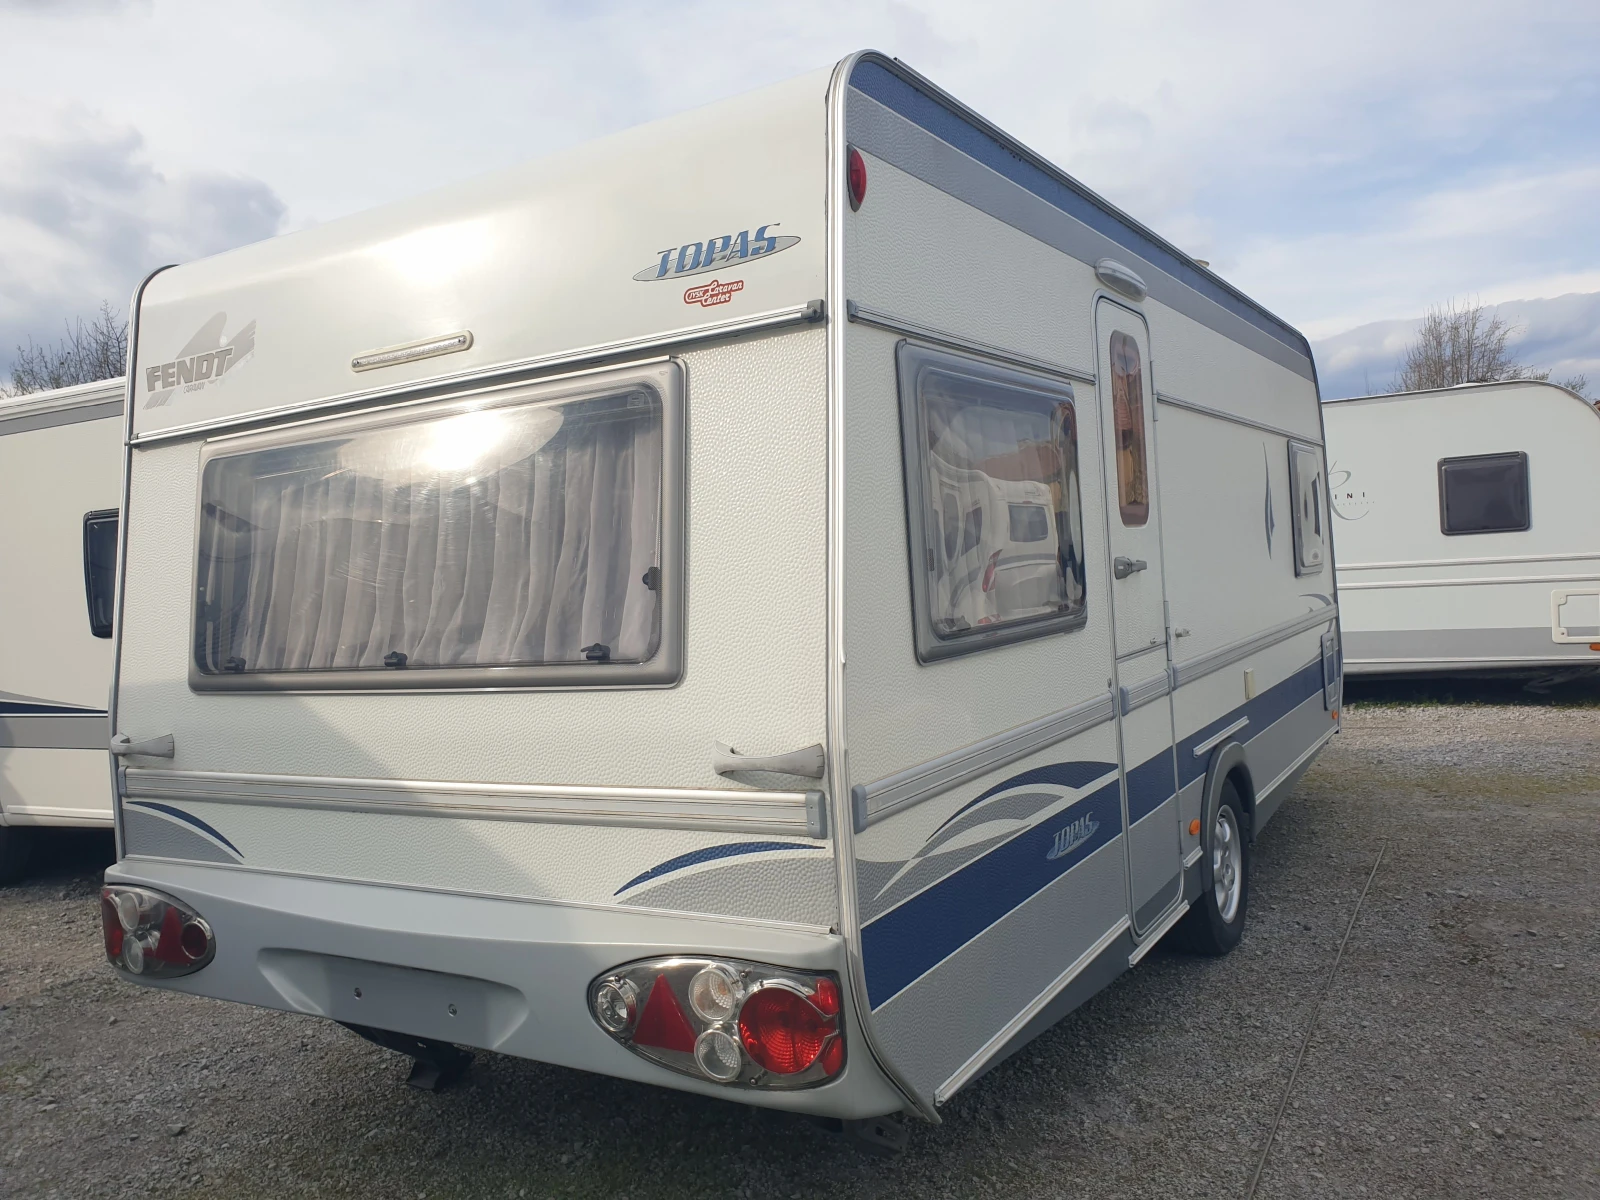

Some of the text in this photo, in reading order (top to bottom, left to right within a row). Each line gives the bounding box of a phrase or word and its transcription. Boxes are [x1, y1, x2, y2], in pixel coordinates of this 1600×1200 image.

[655, 223, 781, 278] TOPAS
[688, 281, 743, 300] JYSK Caravan
[702, 293, 731, 305] Center
[145, 347, 234, 393] FENDT
[1052, 811, 1094, 857] TOPAS
